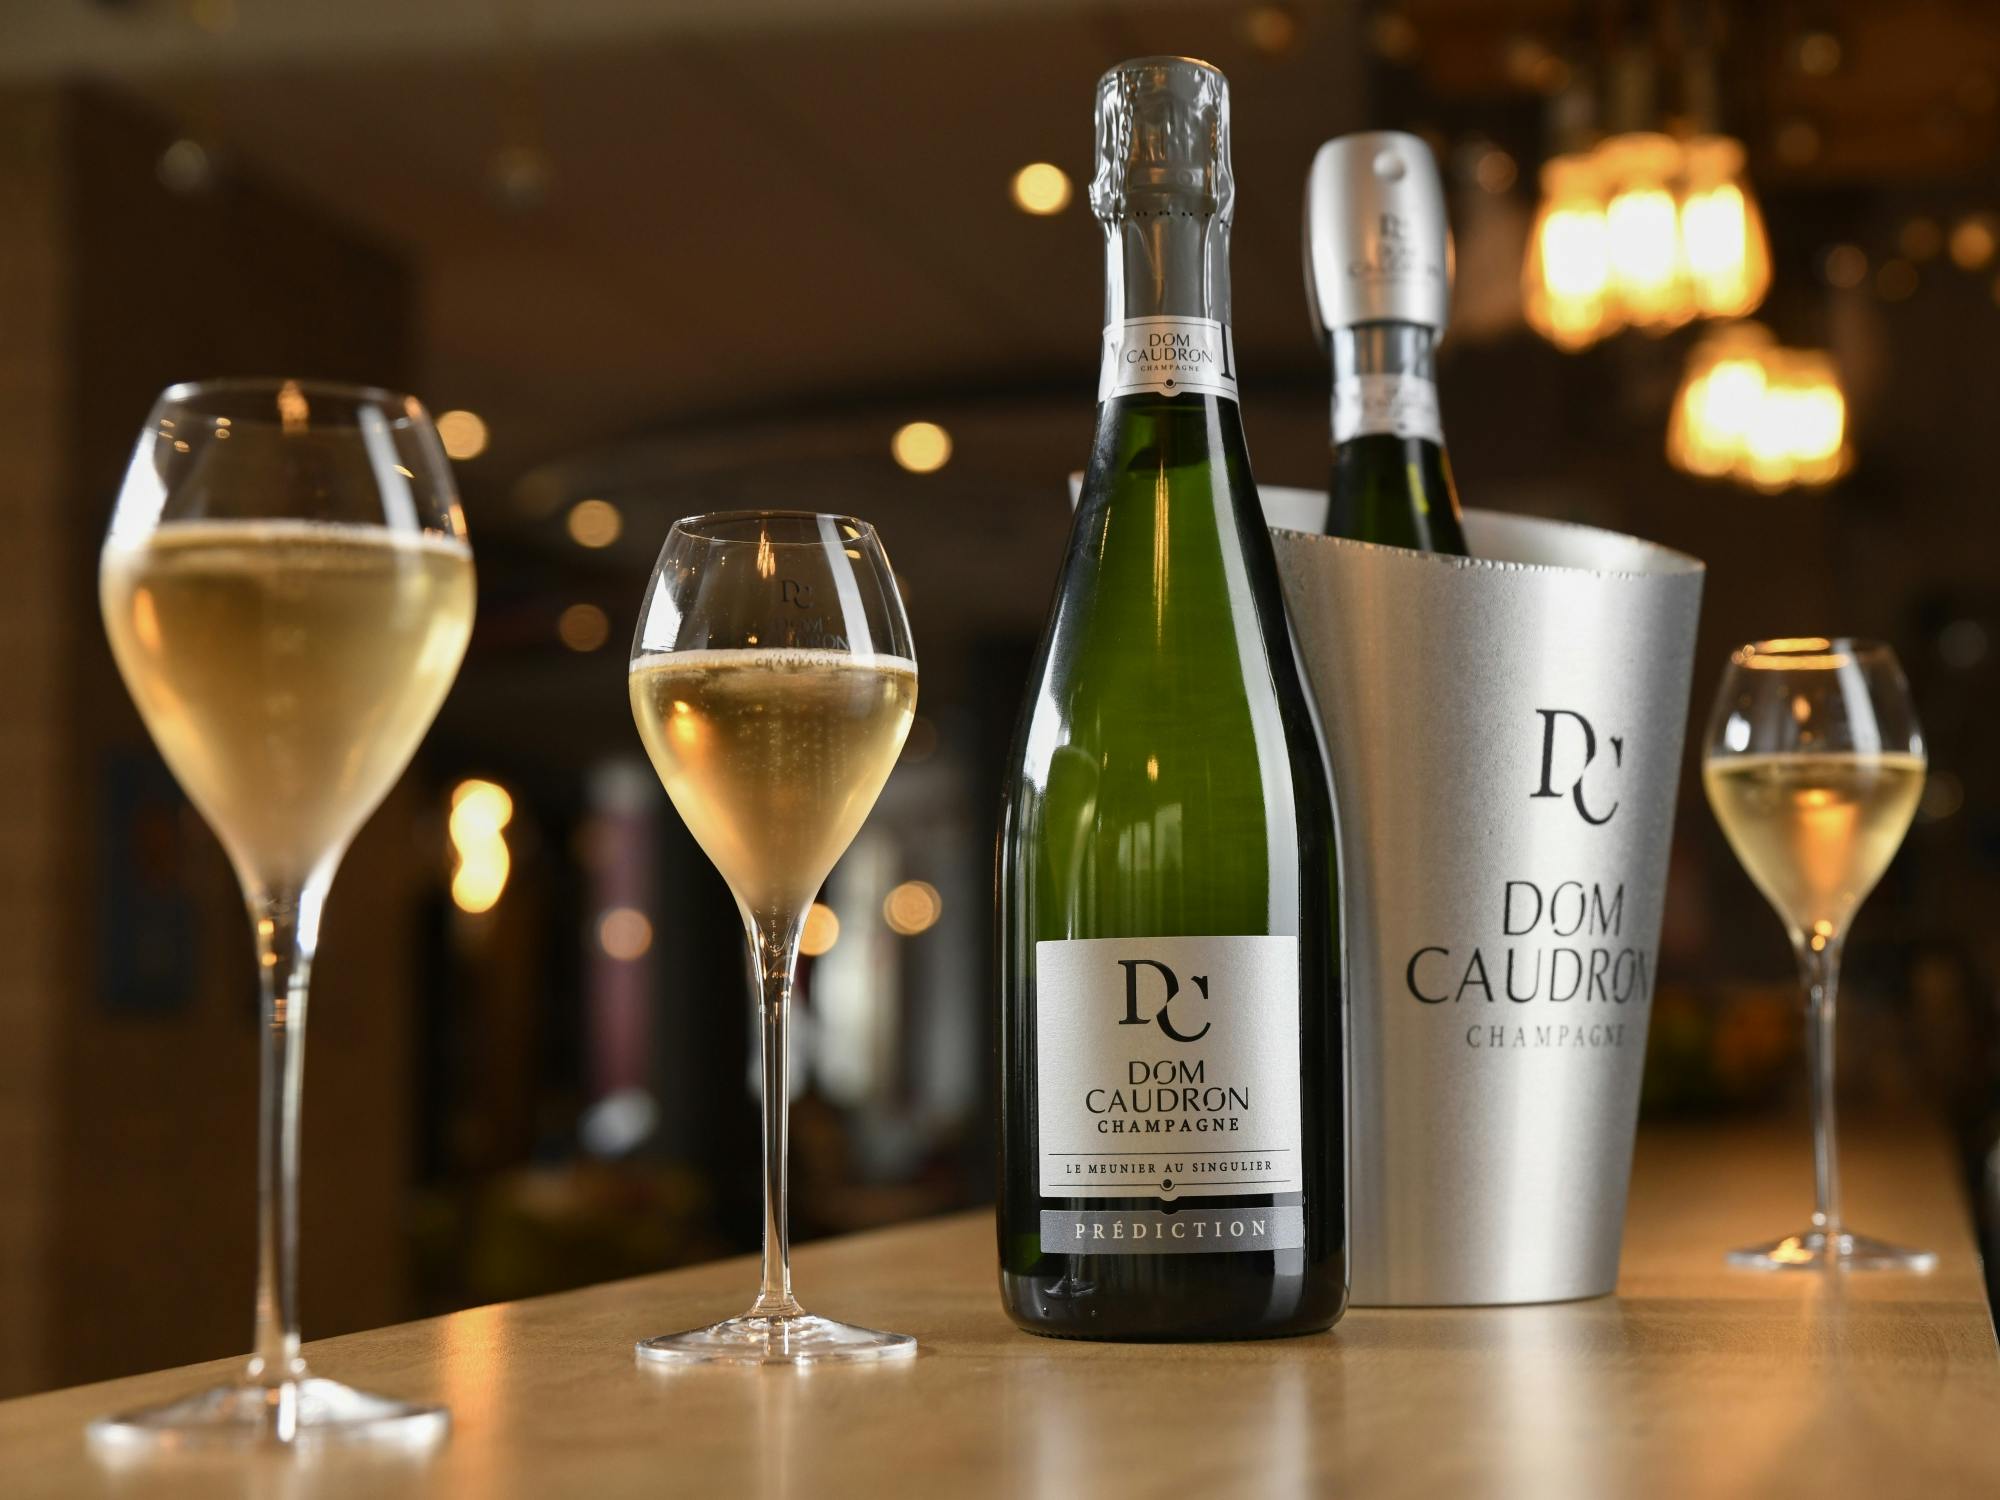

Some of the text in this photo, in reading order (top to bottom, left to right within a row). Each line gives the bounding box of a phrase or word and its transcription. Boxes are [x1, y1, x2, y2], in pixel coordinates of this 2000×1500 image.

[1149, 333, 1190, 347] DOM
[1126, 348, 1213, 364] CAUDRON
[1140, 364, 1200, 372] CHAMPAGNE
[1530, 708, 1623, 826] DC
[1503, 880, 1625, 937] DOM
[1117, 959, 1211, 1042] DC
[1466, 1024, 1625, 1049] CHAMPAGNE
[1128, 1060, 1204, 1085] DOM
[1085, 1086, 1249, 1114] CAUDRON
[1097, 1118, 1240, 1134] CHAMPAGNE
[1066, 1160, 1273, 1175] LE MEUNIER AU SINGULIER
[1075, 1220, 1267, 1240] PRÉDICTION
